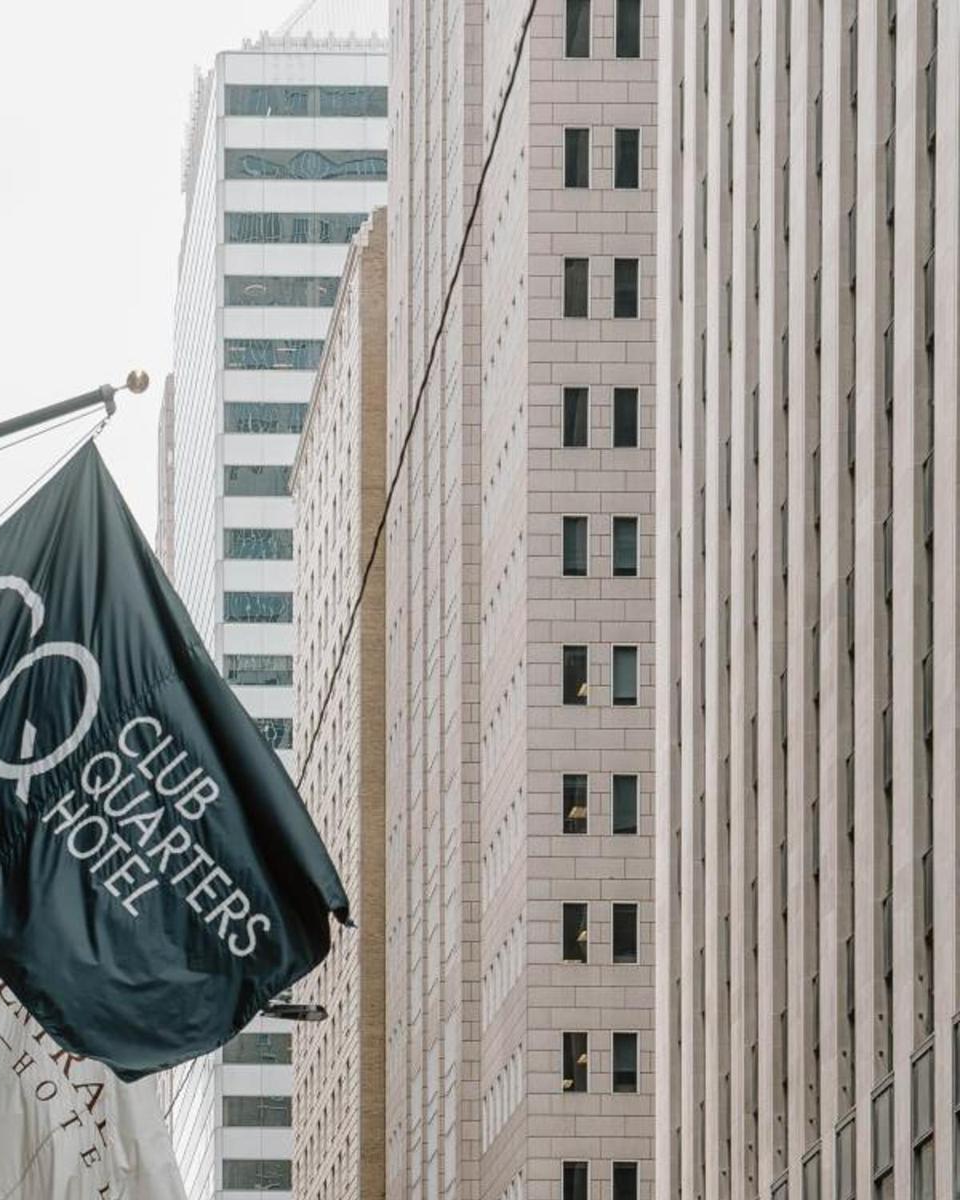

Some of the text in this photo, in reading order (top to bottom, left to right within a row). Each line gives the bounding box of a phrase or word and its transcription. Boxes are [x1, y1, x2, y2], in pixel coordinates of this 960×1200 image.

[118, 716, 220, 820] CLUB
[42, 789, 159, 917] HOTEL
[81, 751, 271, 957] QUARTERS
